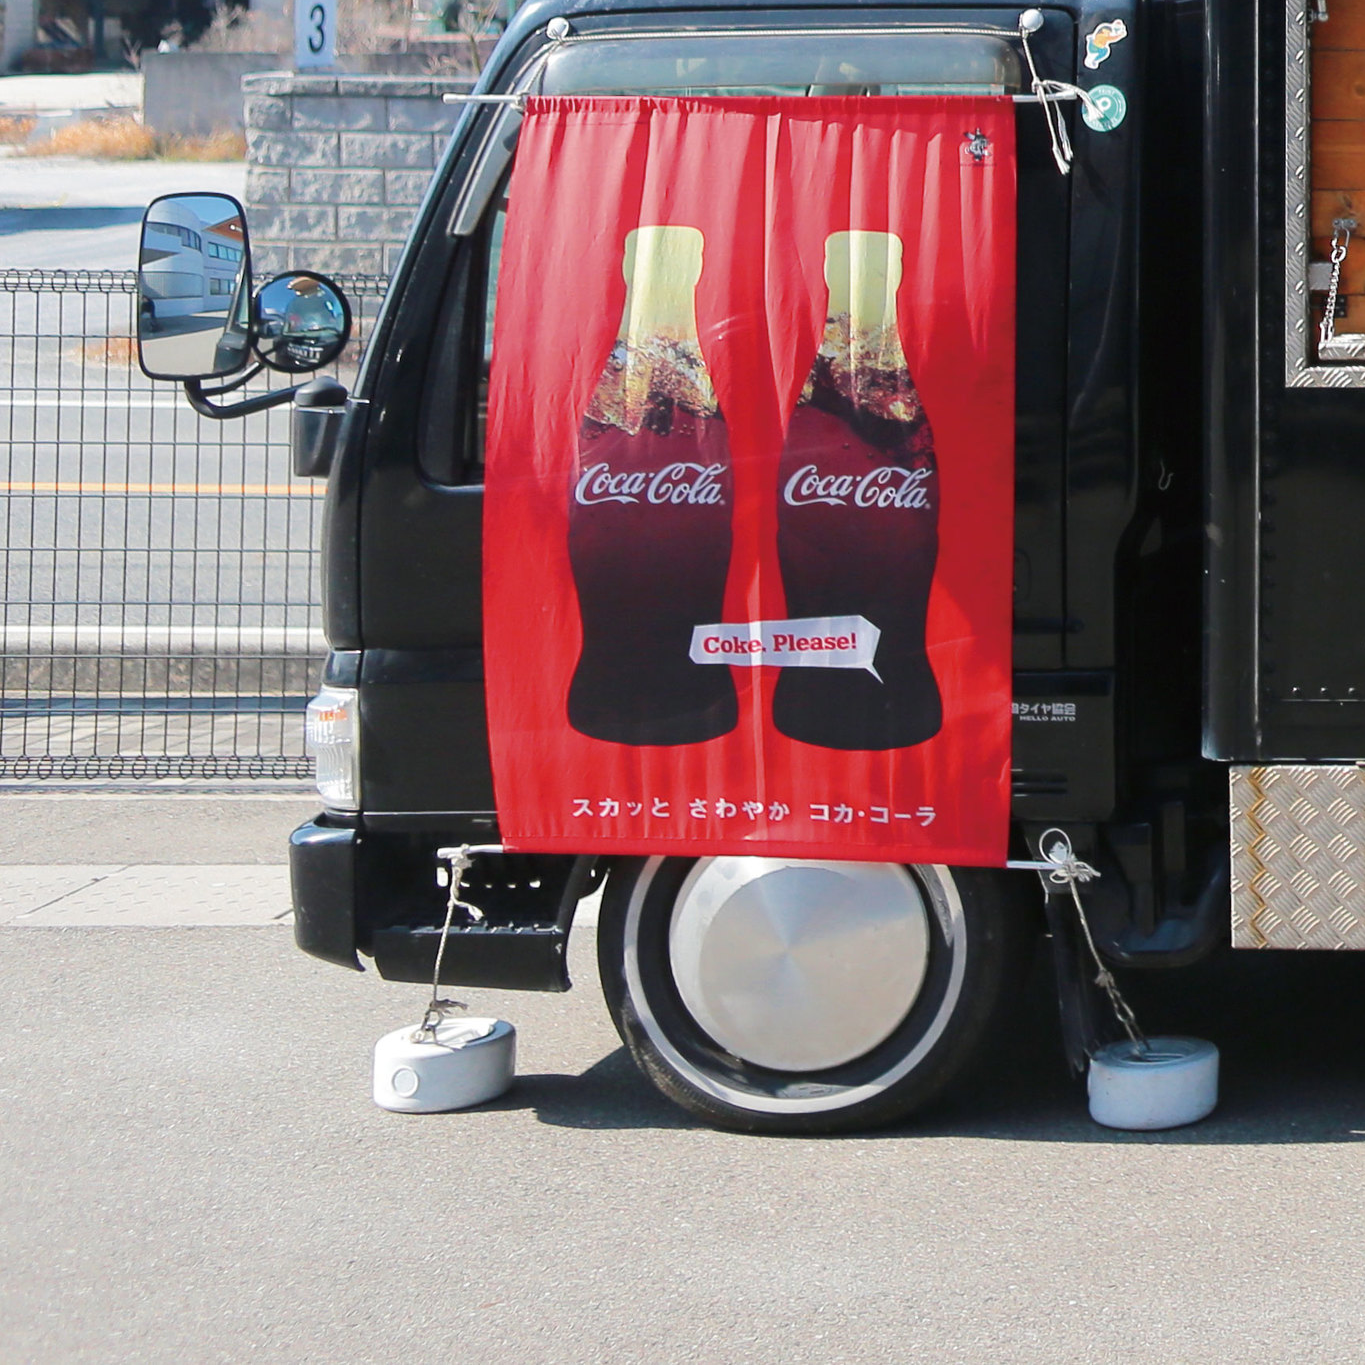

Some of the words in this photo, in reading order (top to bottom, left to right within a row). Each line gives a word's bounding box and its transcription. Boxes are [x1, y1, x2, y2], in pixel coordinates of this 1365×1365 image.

[309, 4, 325, 54] 3
[575, 462, 727, 505] Coca-Cola
[783, 464, 932, 509] Coca-Cola
[703, 635, 767, 654] Coke.
[773, 632, 857, 652] Please!
[572, 797, 671, 818] スカッと
[688, 797, 790, 821] さわやか
[809, 802, 937, 827] コカ・コーラ
